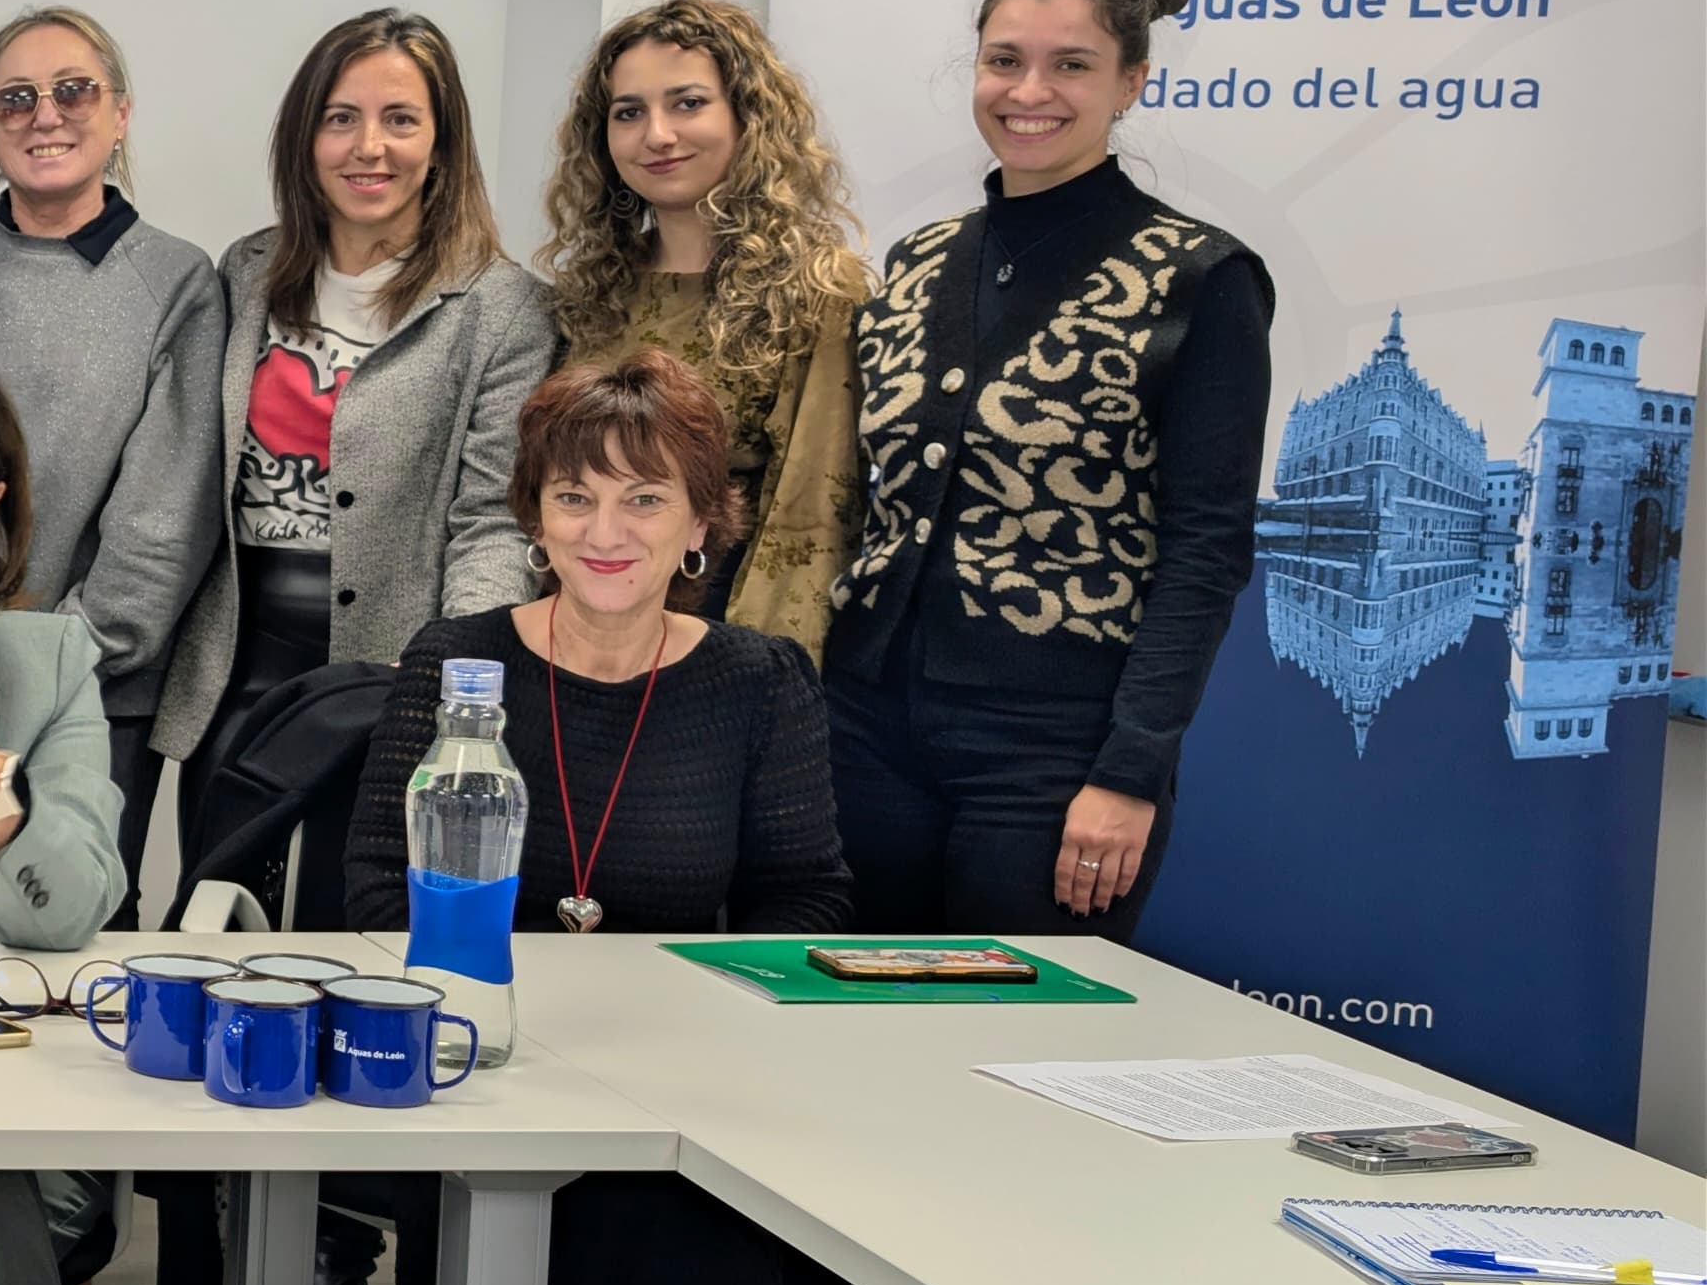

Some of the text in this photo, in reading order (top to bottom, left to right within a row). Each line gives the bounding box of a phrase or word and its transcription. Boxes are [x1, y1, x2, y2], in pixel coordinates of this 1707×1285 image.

[1292, 66, 1380, 110] del
[1398, 75, 1541, 121] agua
[347, 1047, 405, 1060] Aguas de León
